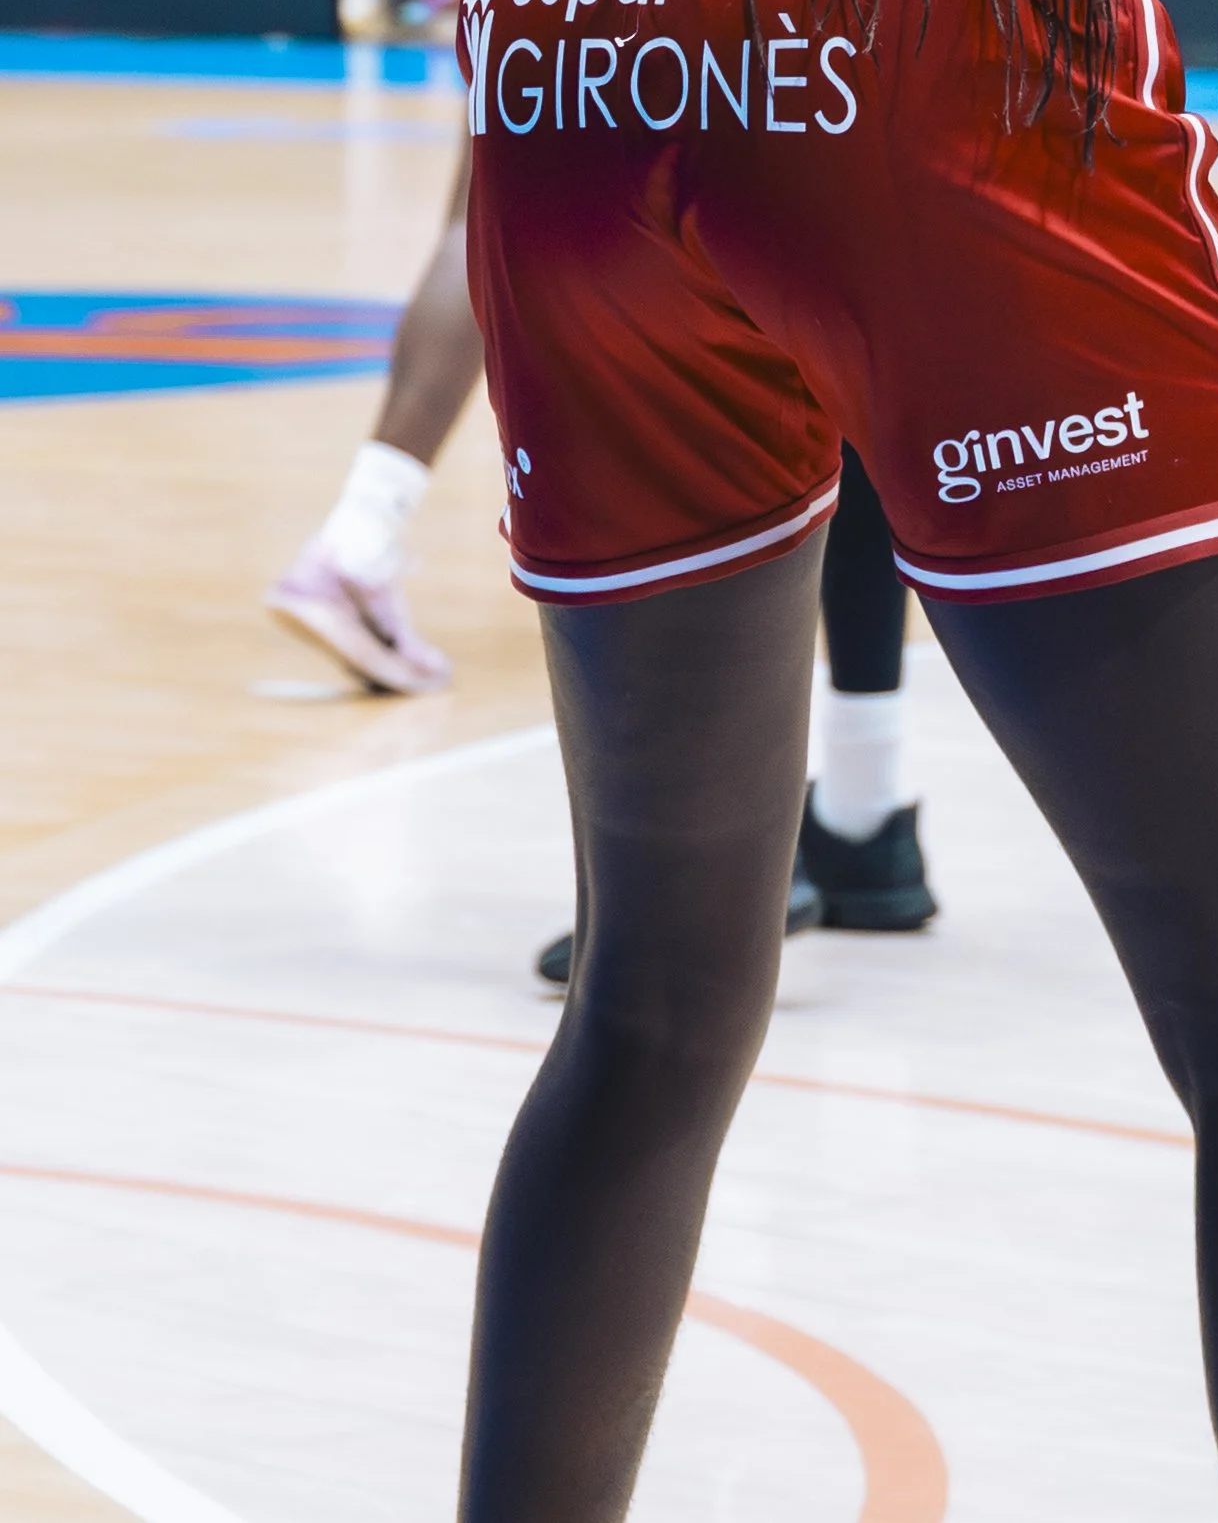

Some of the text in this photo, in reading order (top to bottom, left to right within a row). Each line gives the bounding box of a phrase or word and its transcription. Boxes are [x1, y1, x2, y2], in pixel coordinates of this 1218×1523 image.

[497, 12, 858, 134] GIRONÈS
[933, 391, 1149, 503] ginvest
[996, 449, 1149, 493] ASSET MANAGEMENT
